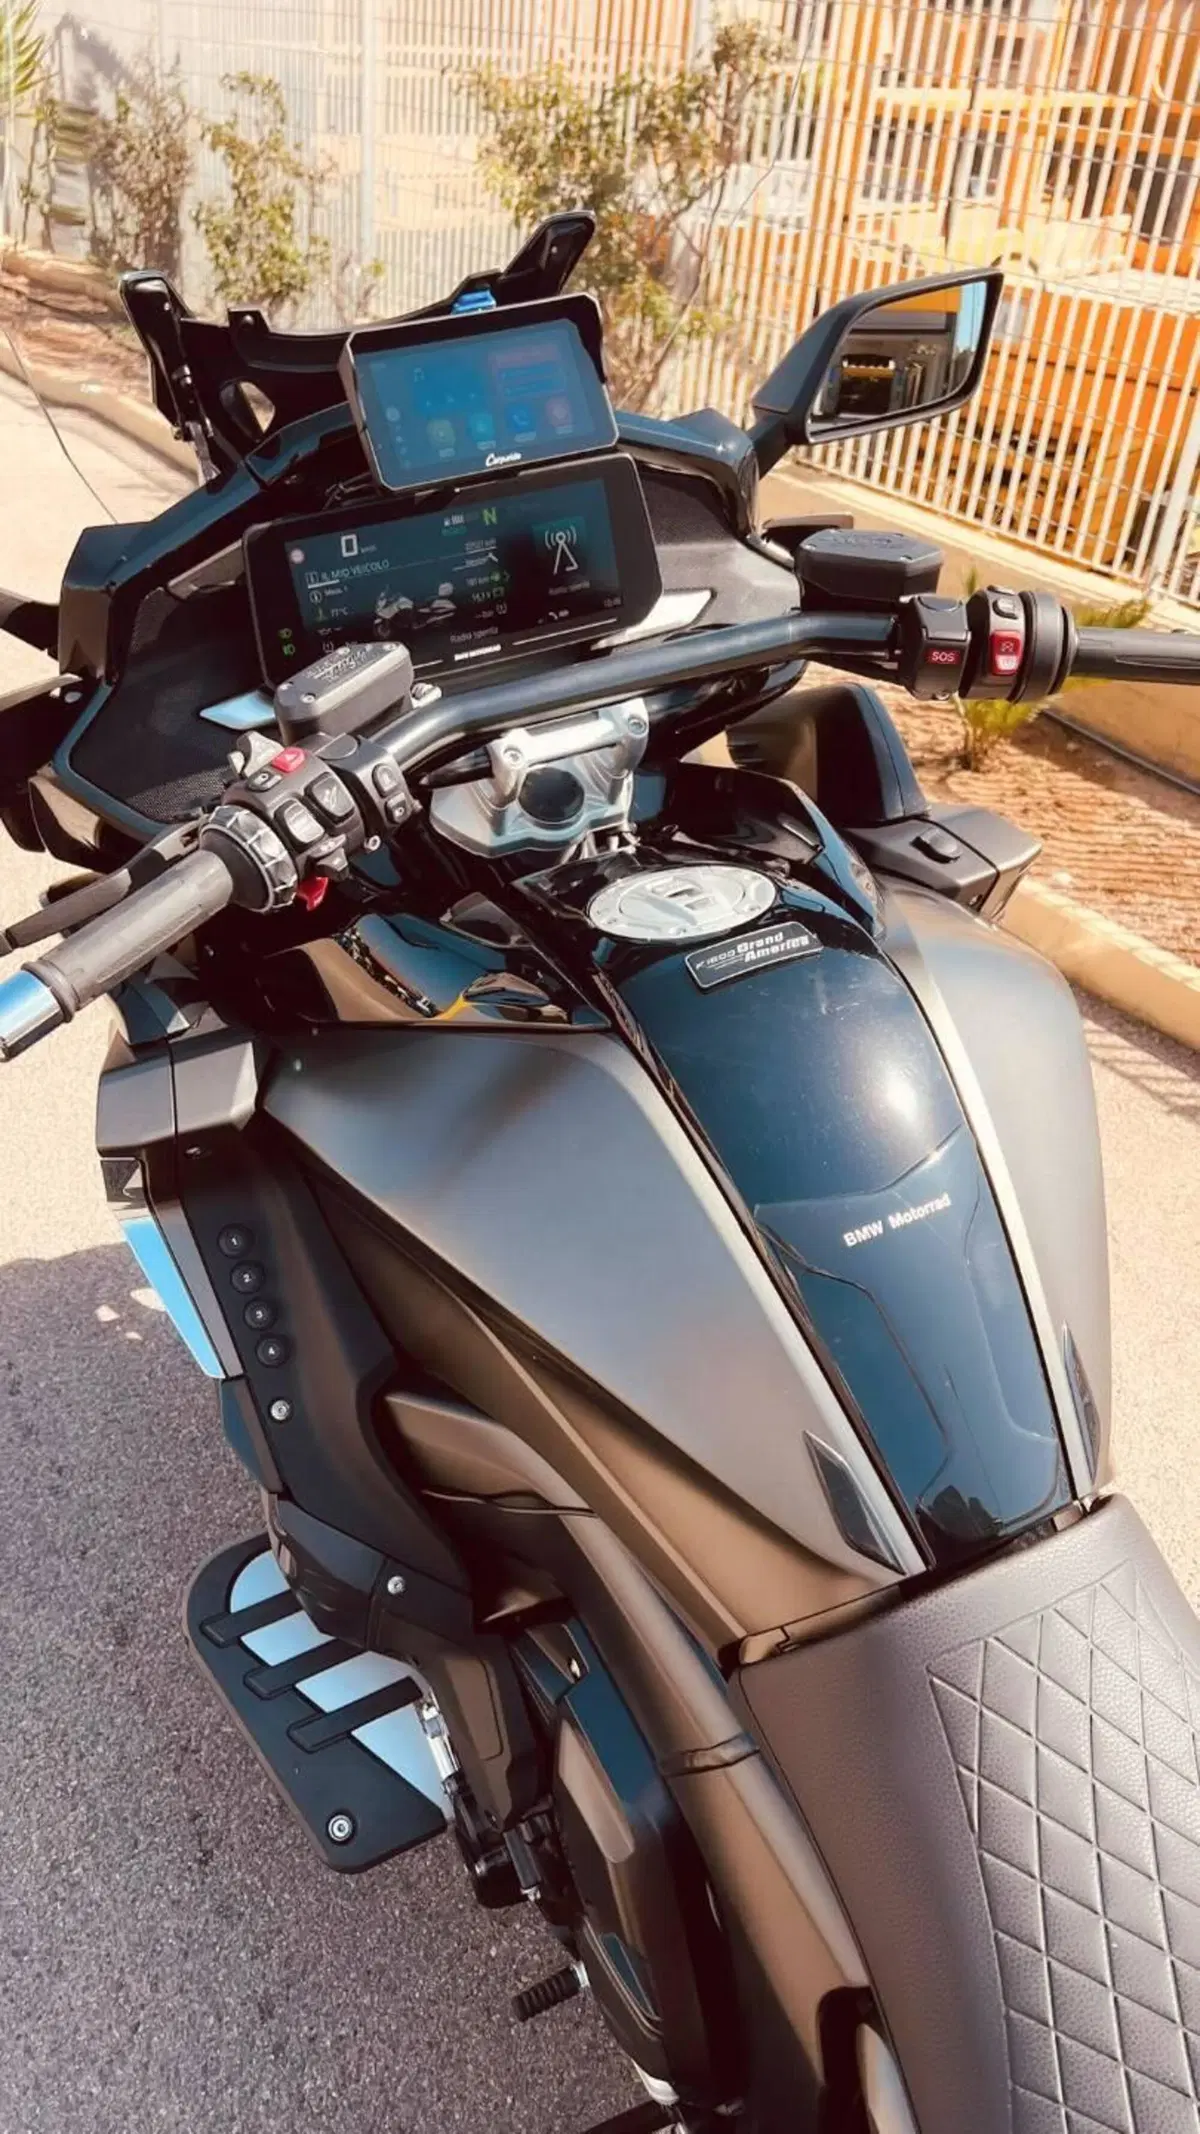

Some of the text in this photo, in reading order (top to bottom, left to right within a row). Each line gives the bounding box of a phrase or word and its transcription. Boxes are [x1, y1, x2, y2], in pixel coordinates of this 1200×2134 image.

[483, 508, 498, 525] N
[340, 534, 358, 557] 0
[350, 559, 389, 576] VEICOLO
[931, 651, 956, 663] SOS
[736, 931, 784, 953] Grand
[744, 935, 810, 962] America
[843, 1192, 952, 1248] BMW Motorrad
[231, 1237, 238, 1246] 1
[243, 1274, 251, 1283] 2
[256, 1310, 263, 1319] 3
[268, 1346, 276, 1355] 4
